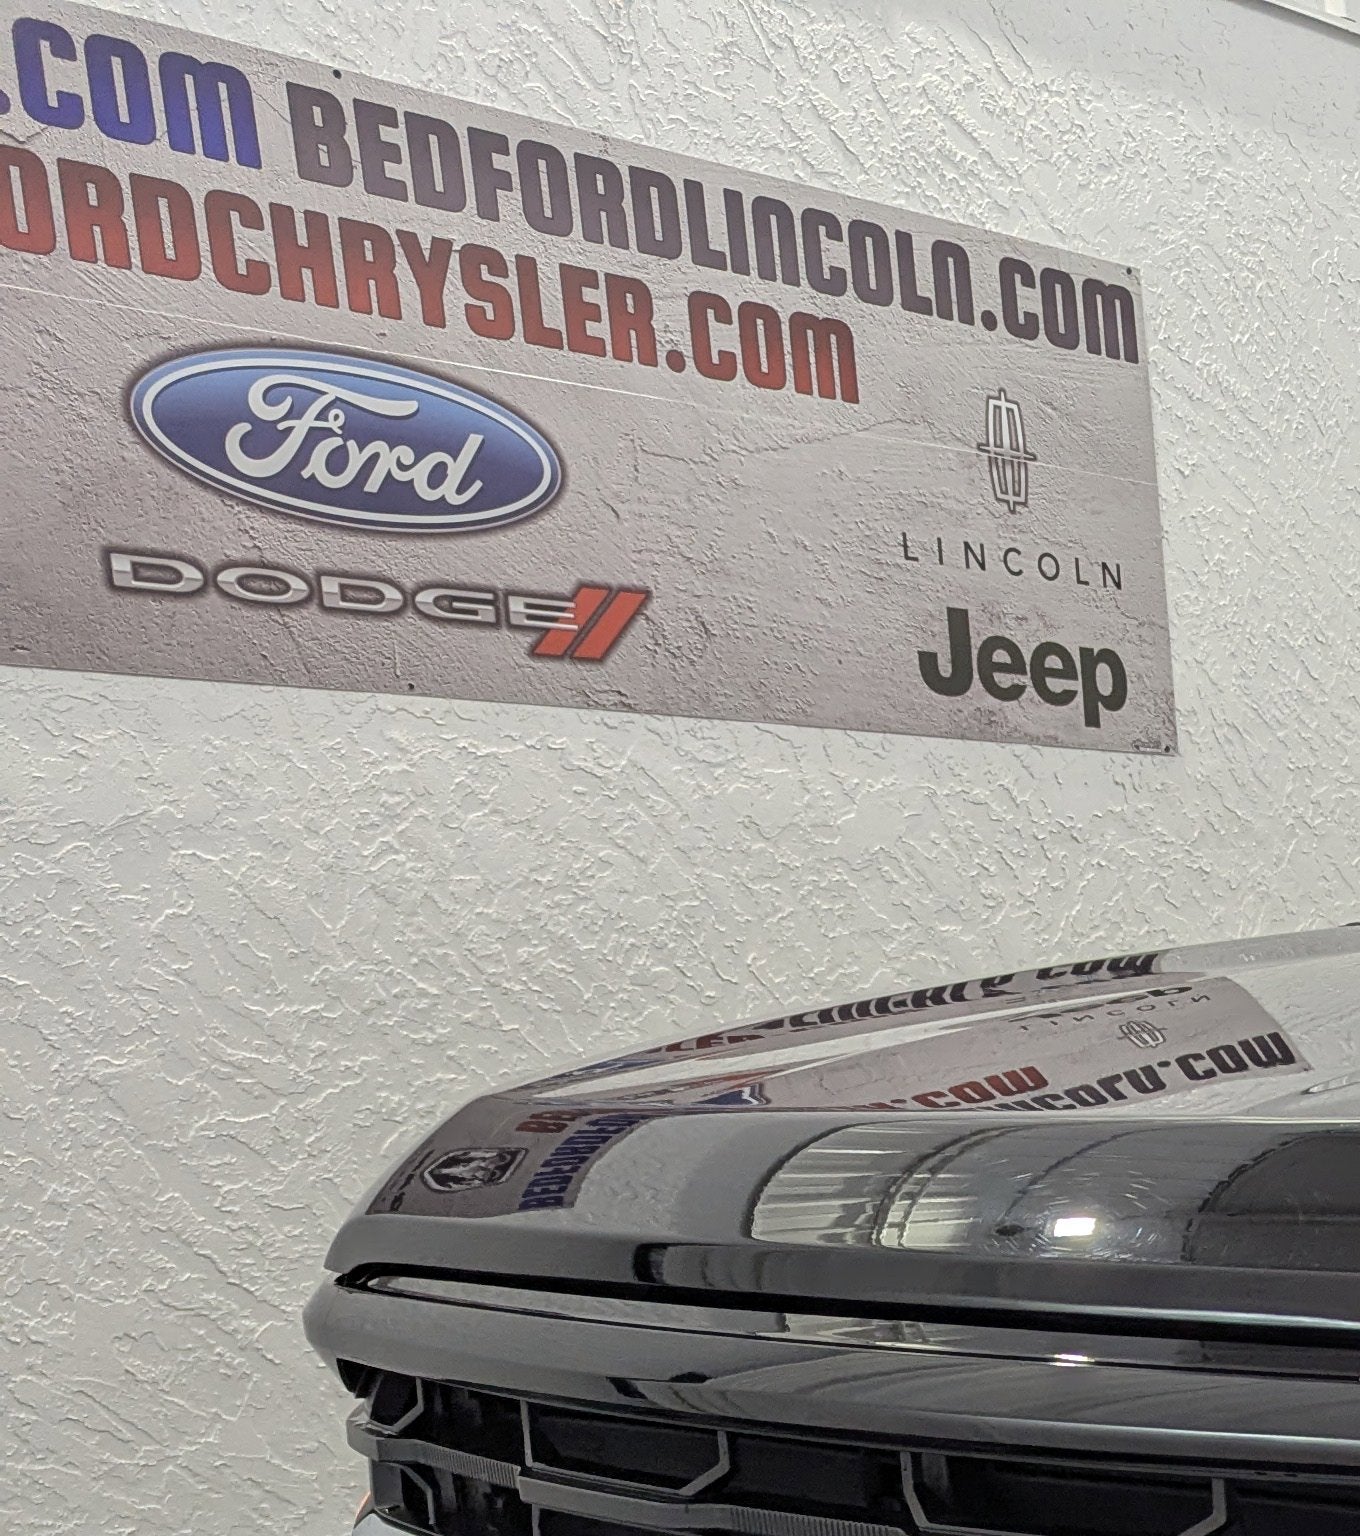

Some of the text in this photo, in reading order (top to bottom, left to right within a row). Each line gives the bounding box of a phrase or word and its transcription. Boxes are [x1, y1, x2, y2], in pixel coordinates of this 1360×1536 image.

[286, 81, 1139, 365] BEDFORDLINCOLN.COM
[225, 373, 487, 507] Ford
[109, 551, 579, 631] DODGE
[901, 531, 1122, 590] LINCOLN
[918, 606, 1128, 727] Jeep
